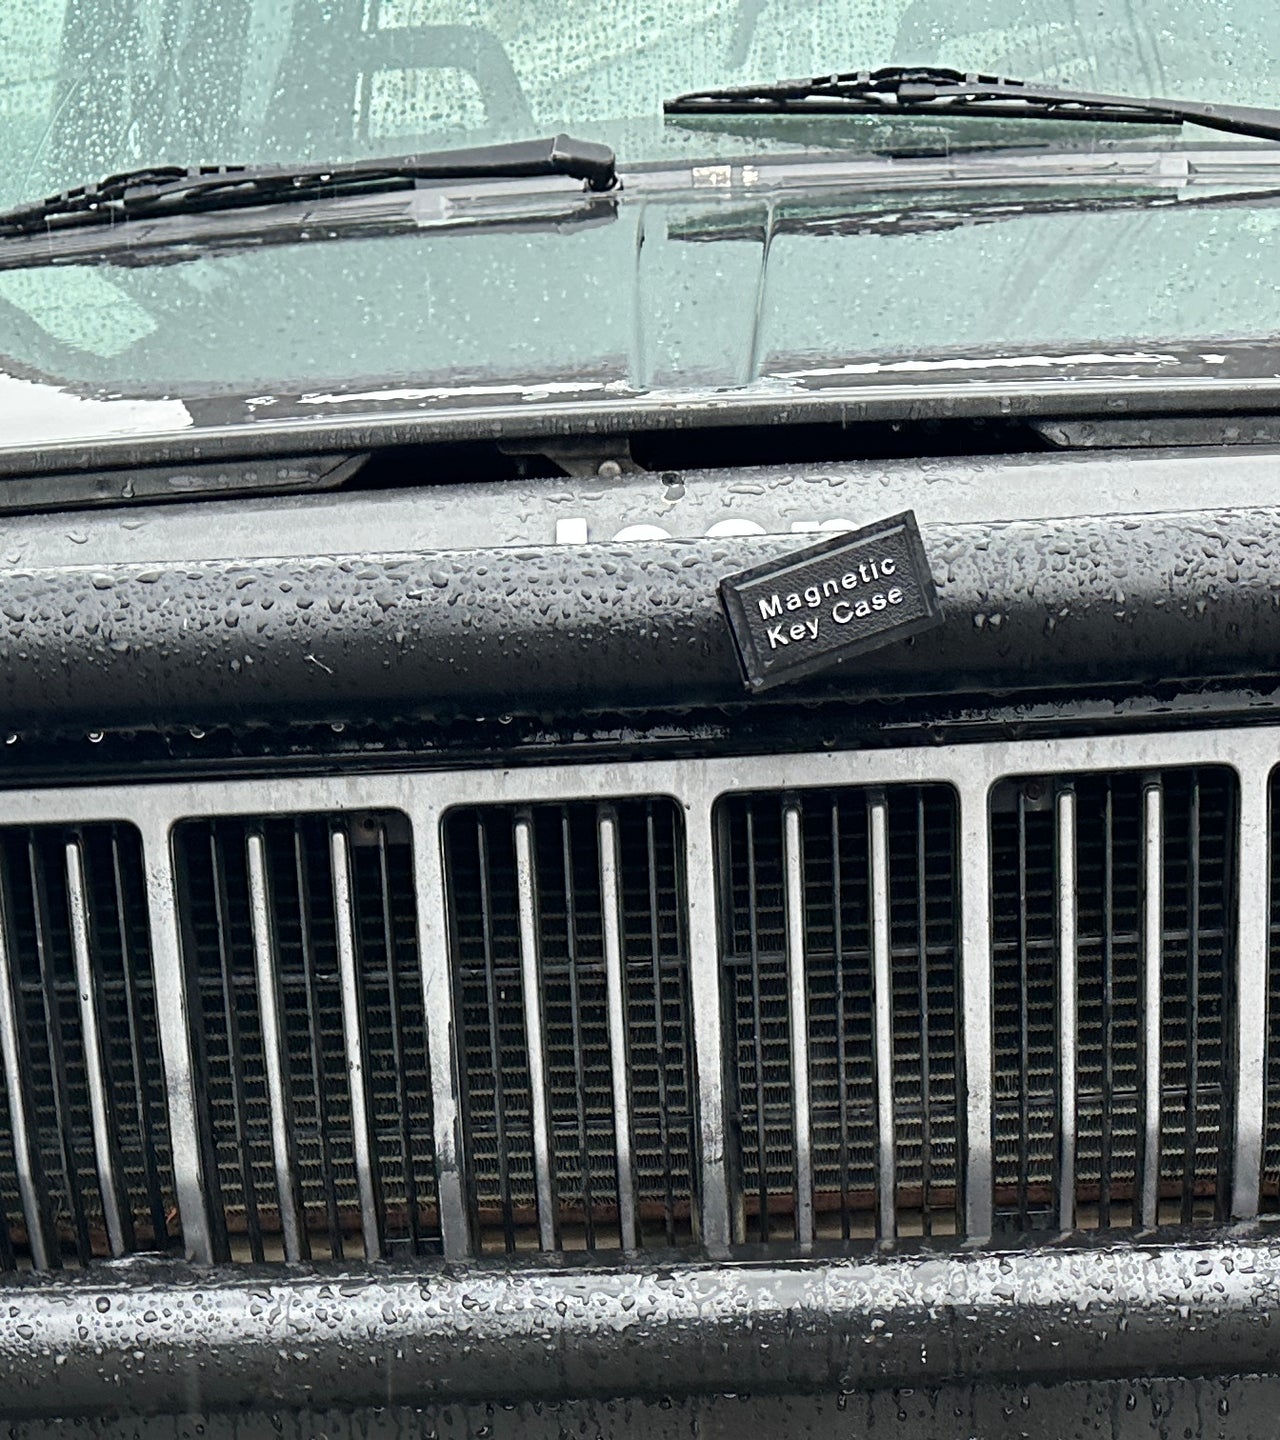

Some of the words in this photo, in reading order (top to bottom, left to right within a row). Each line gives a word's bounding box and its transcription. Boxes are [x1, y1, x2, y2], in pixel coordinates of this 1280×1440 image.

[758, 558, 896, 619] Magnetic
[766, 618, 819, 648] Key
[832, 588, 903, 623] Case
